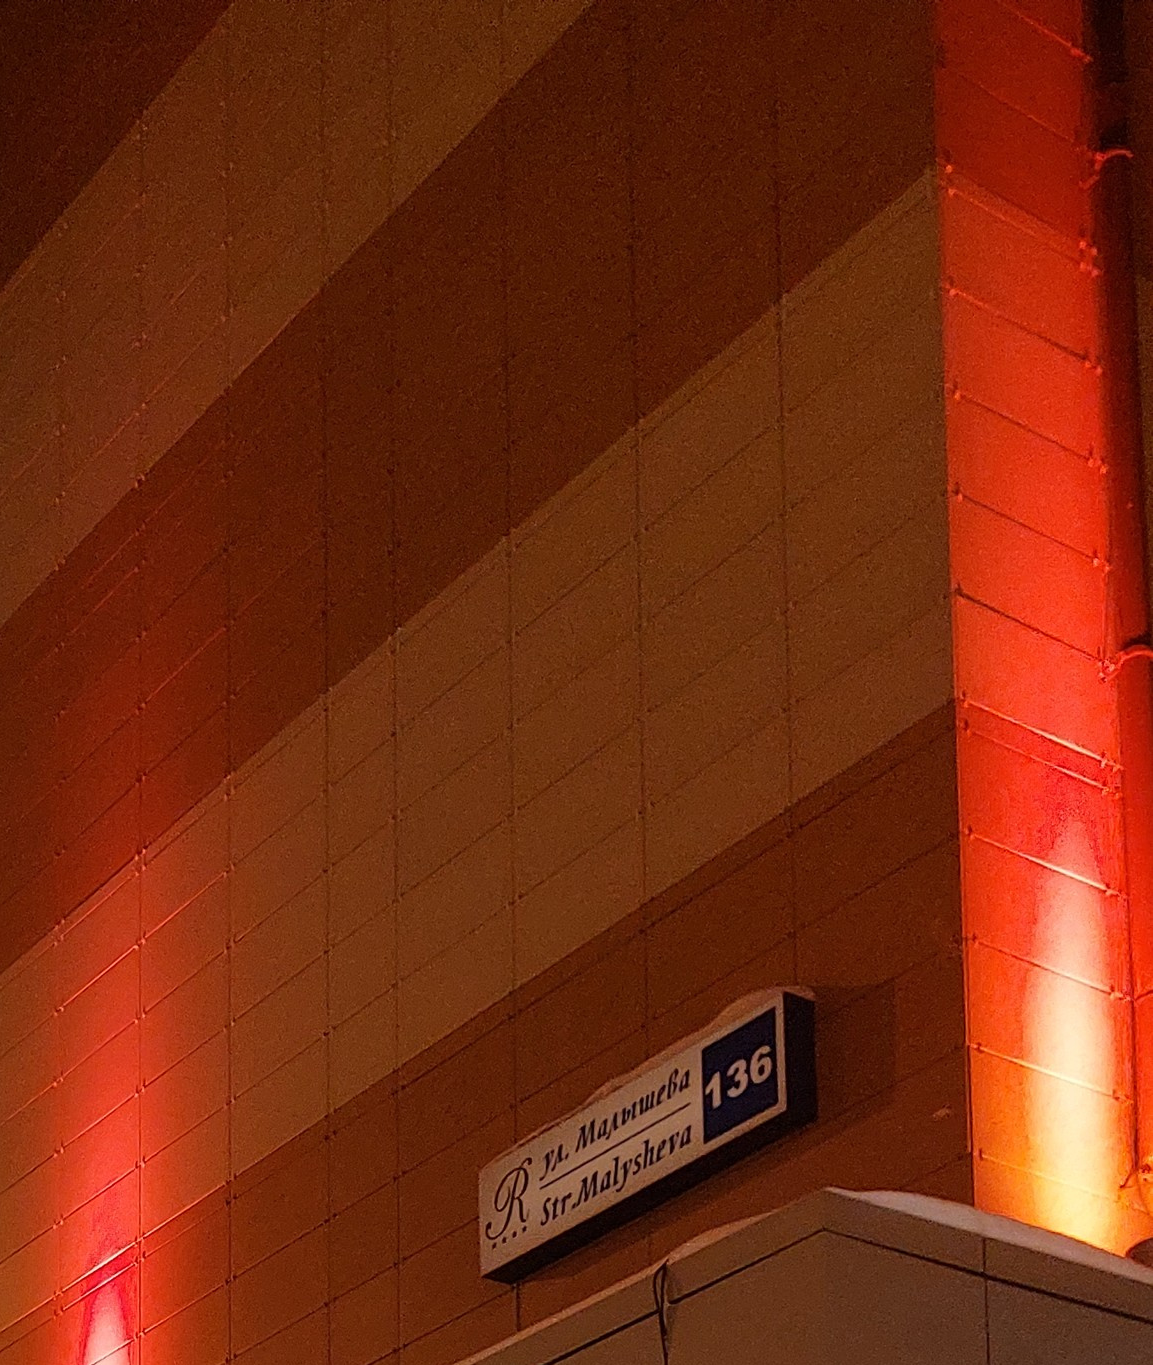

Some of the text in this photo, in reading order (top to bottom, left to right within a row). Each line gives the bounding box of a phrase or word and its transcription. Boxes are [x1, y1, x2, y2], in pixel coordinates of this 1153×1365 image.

[705, 1044, 774, 1111] 136
[539, 1067, 691, 1183] ул. Малышева
